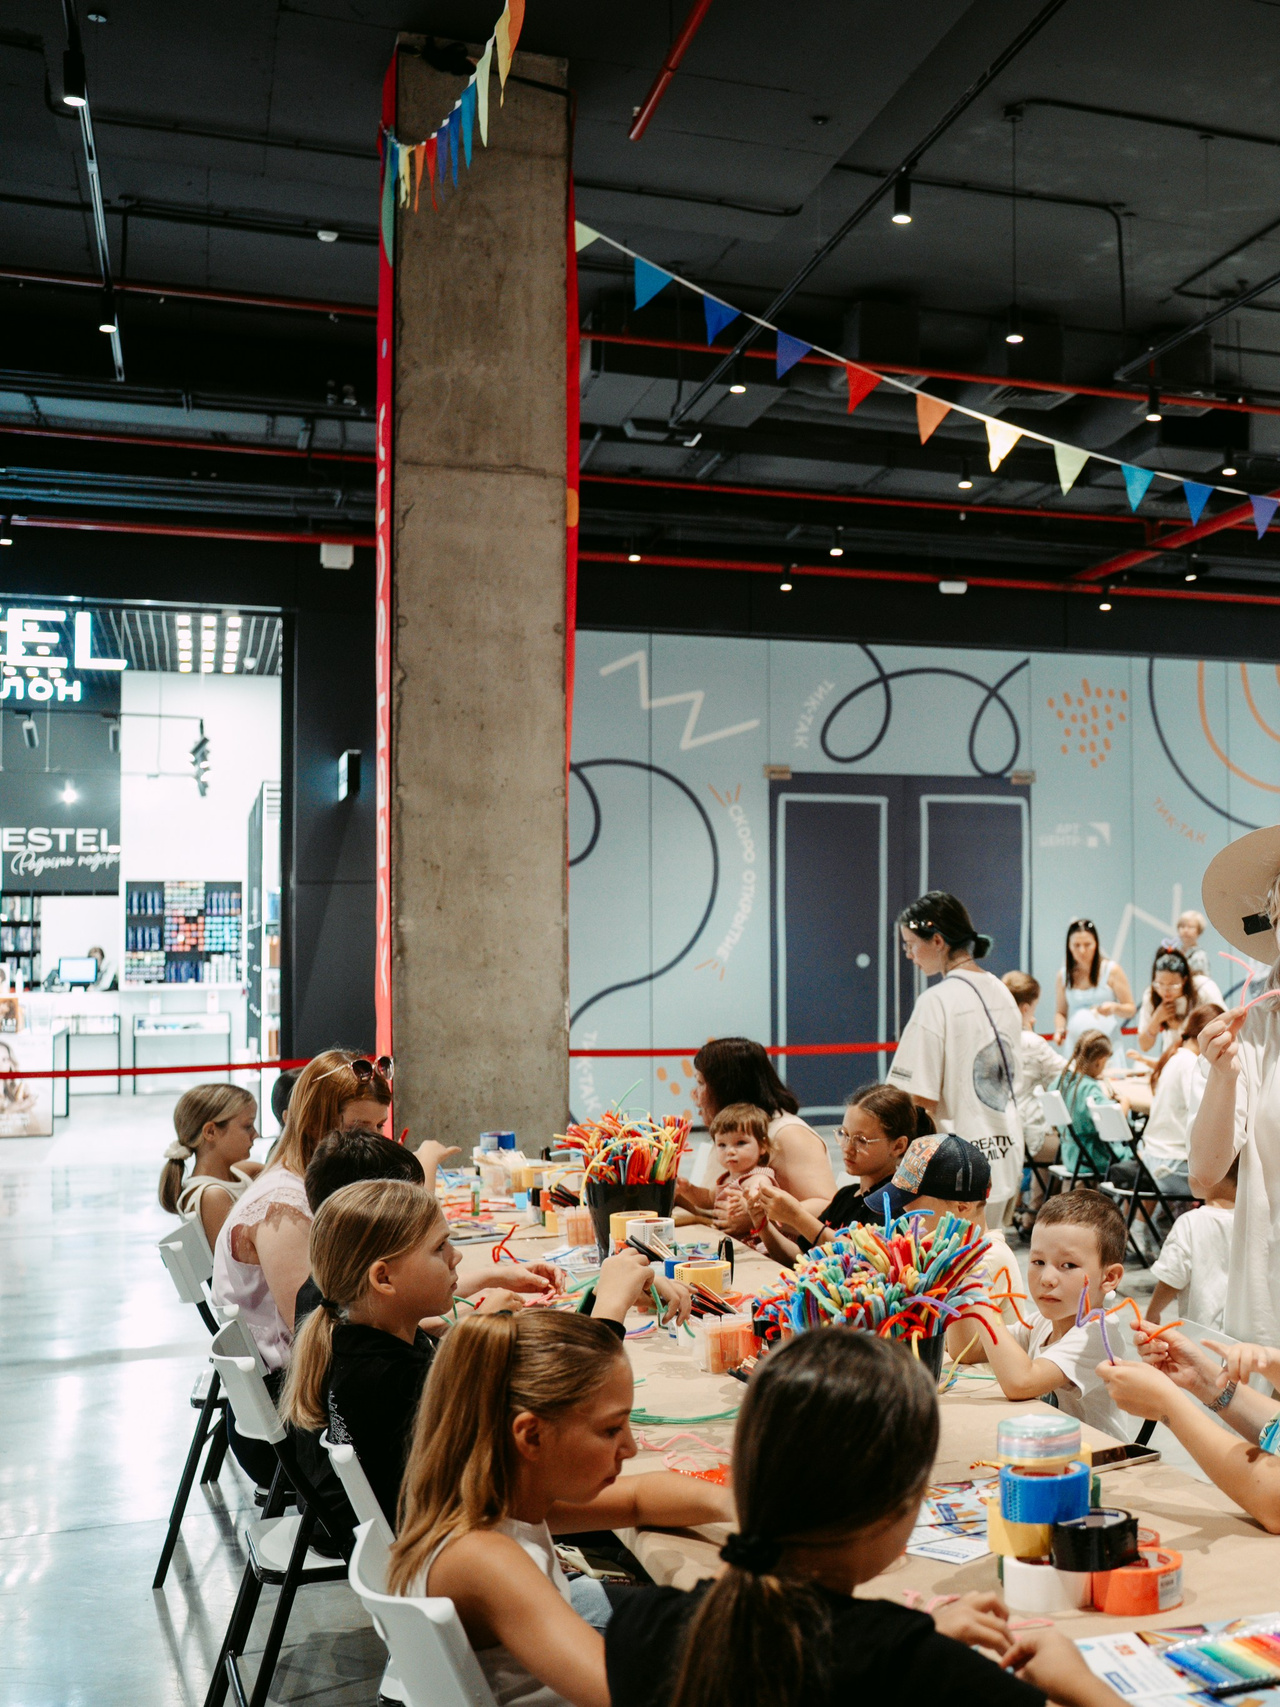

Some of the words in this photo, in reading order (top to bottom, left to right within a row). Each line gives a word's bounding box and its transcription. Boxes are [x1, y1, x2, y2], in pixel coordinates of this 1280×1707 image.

[0, 607, 128, 671] EL
[795, 679, 836, 750] ТИК-ТАК
[1, 826, 121, 853] ESTEL
[728, 803, 756, 864] СКОРО
[715, 868, 757, 962] ОТКРЫТИЕ
